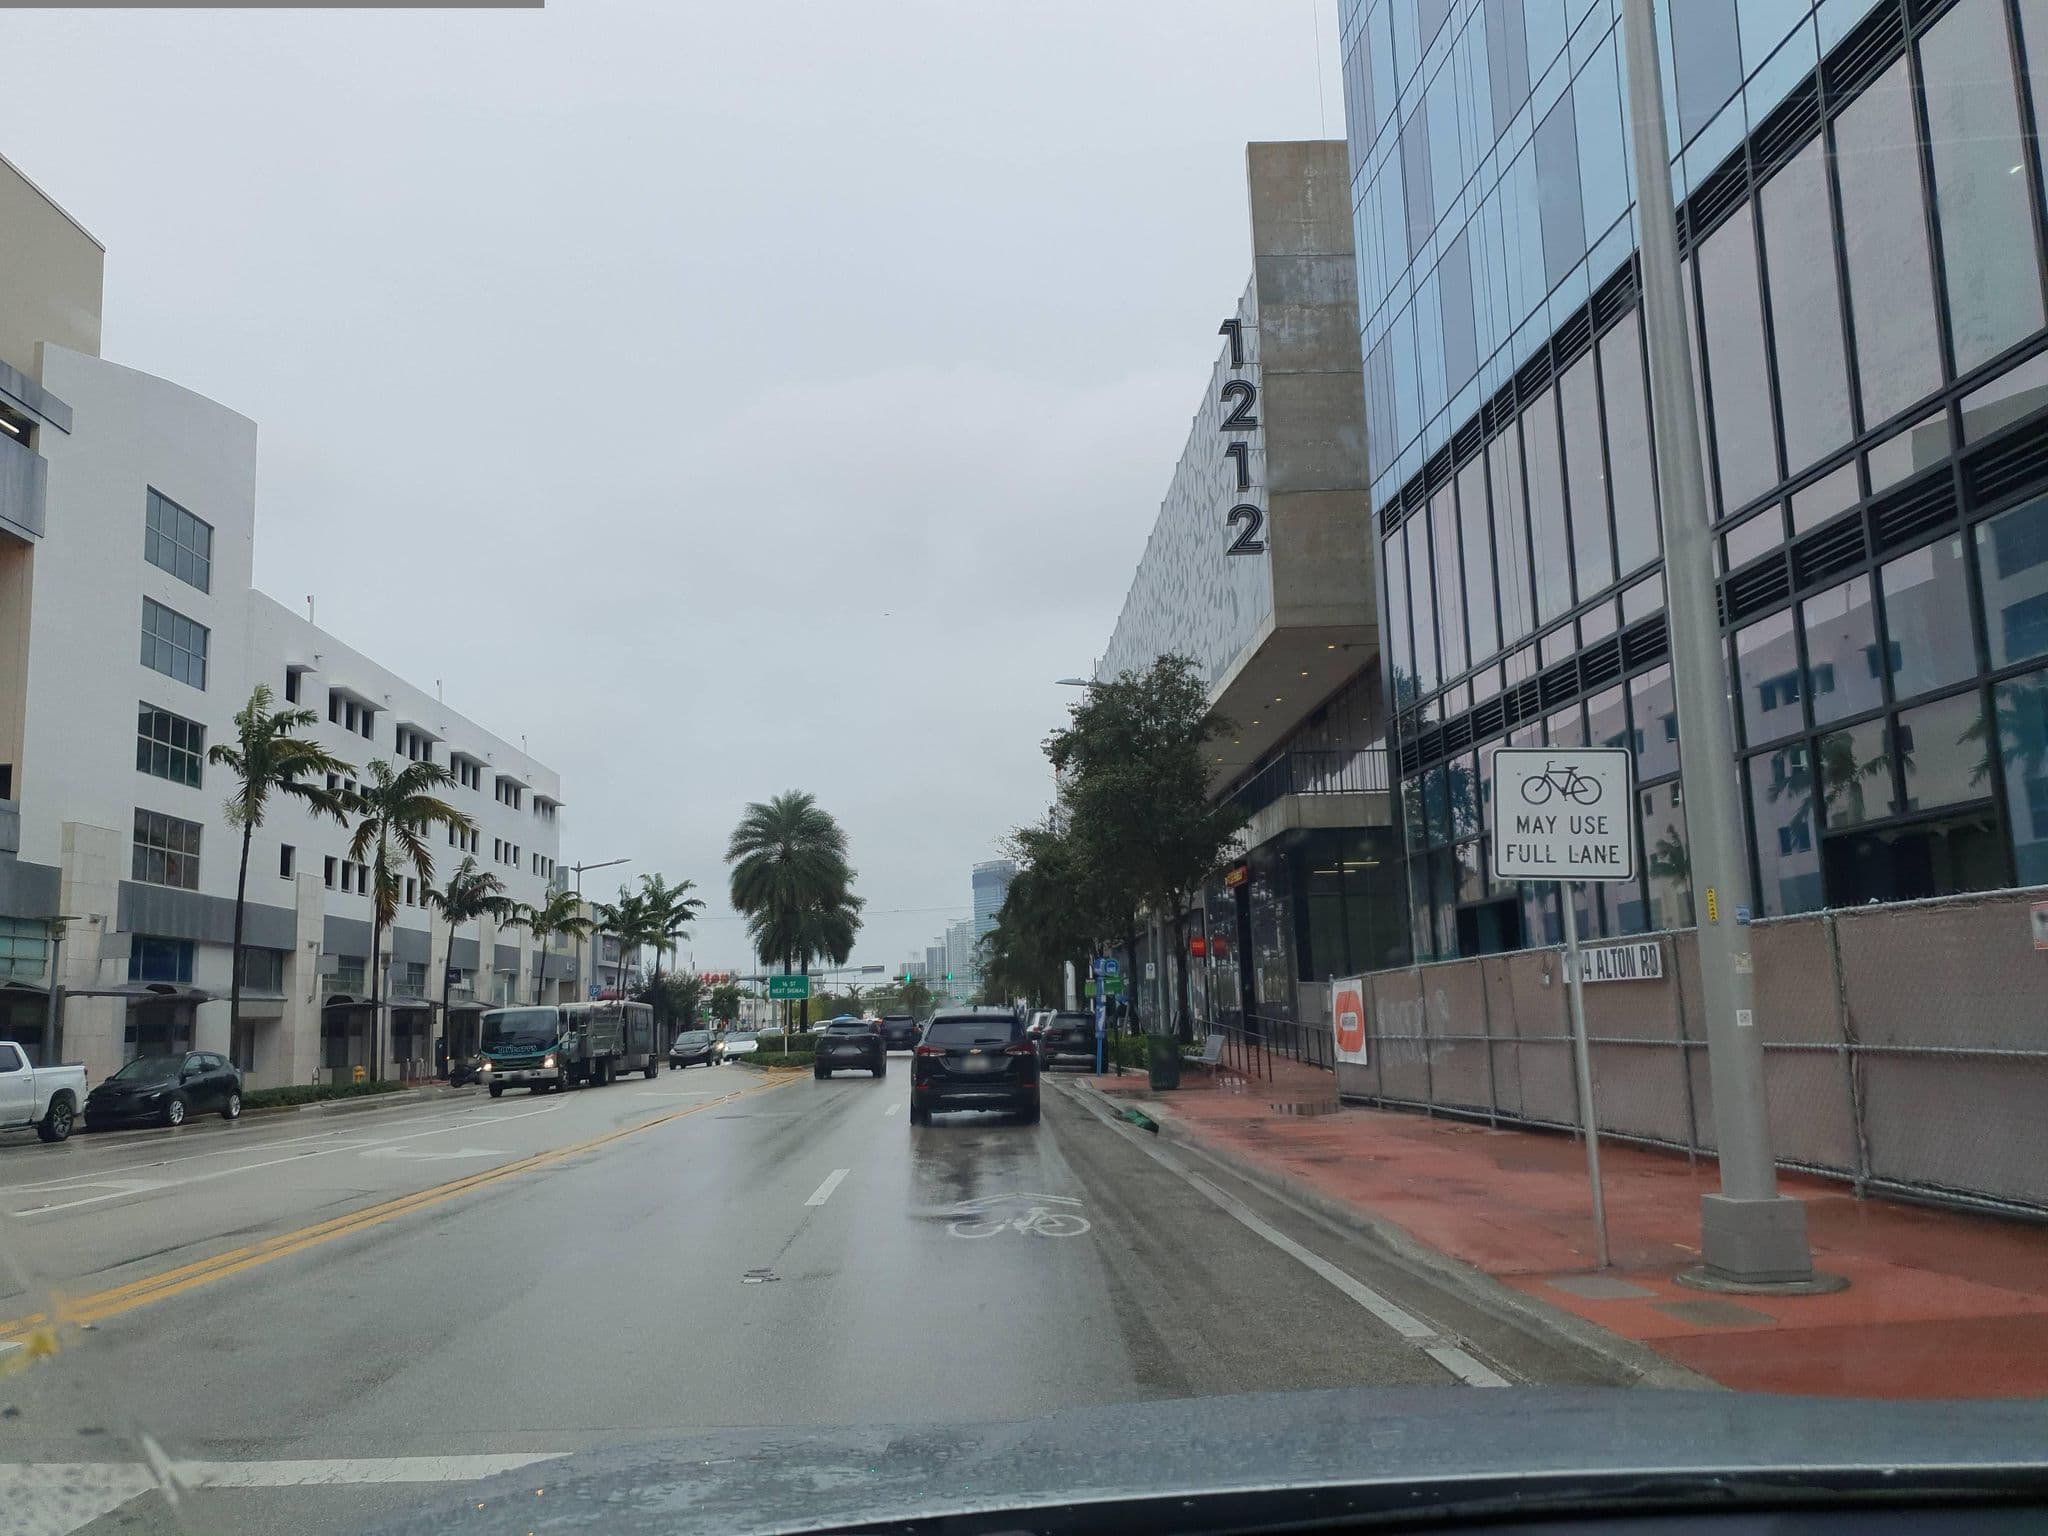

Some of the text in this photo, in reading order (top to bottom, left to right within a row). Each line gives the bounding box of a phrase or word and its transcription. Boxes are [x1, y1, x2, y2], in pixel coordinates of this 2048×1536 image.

[1218, 319, 1264, 556] 1212
[1516, 815, 1609, 835] MAY USE
[1506, 844, 1620, 864] FULL LANE
[1596, 946, 1637, 979] ALTON
[1640, 945, 1658, 976] RD
